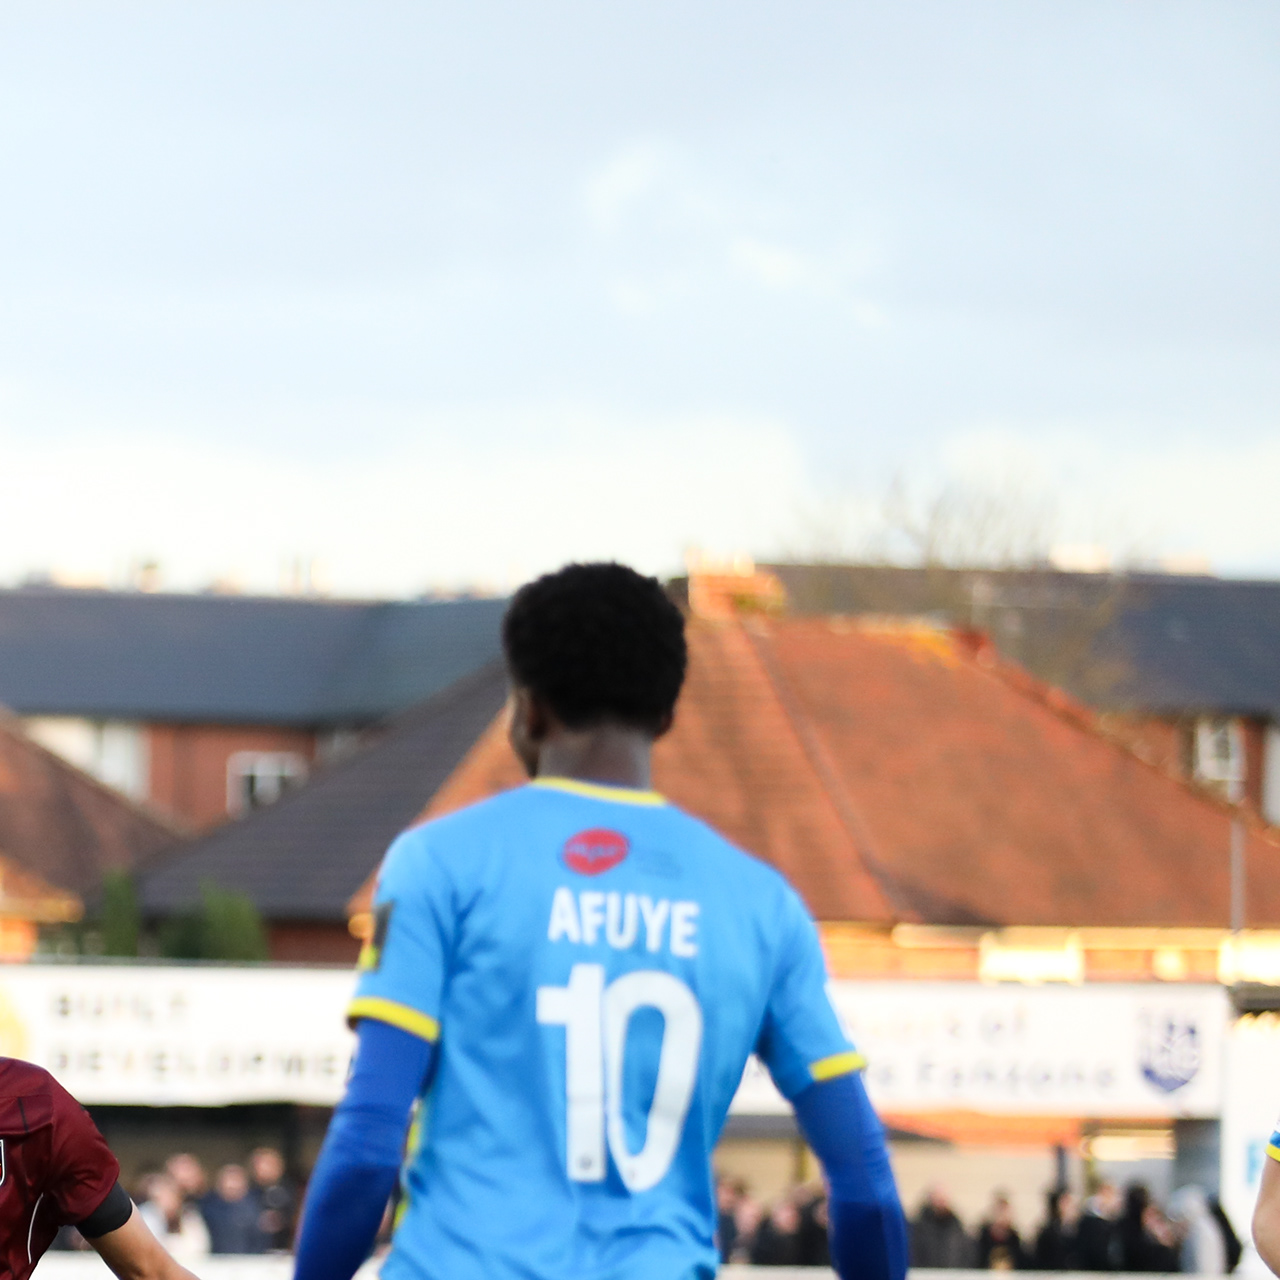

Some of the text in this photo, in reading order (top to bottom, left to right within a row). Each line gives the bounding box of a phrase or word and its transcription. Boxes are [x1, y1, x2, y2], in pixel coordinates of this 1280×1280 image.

[547, 887, 700, 957] AFUYE
[49, 1043, 340, 1079] DEVELOPME
[536, 963, 703, 1193] 10
